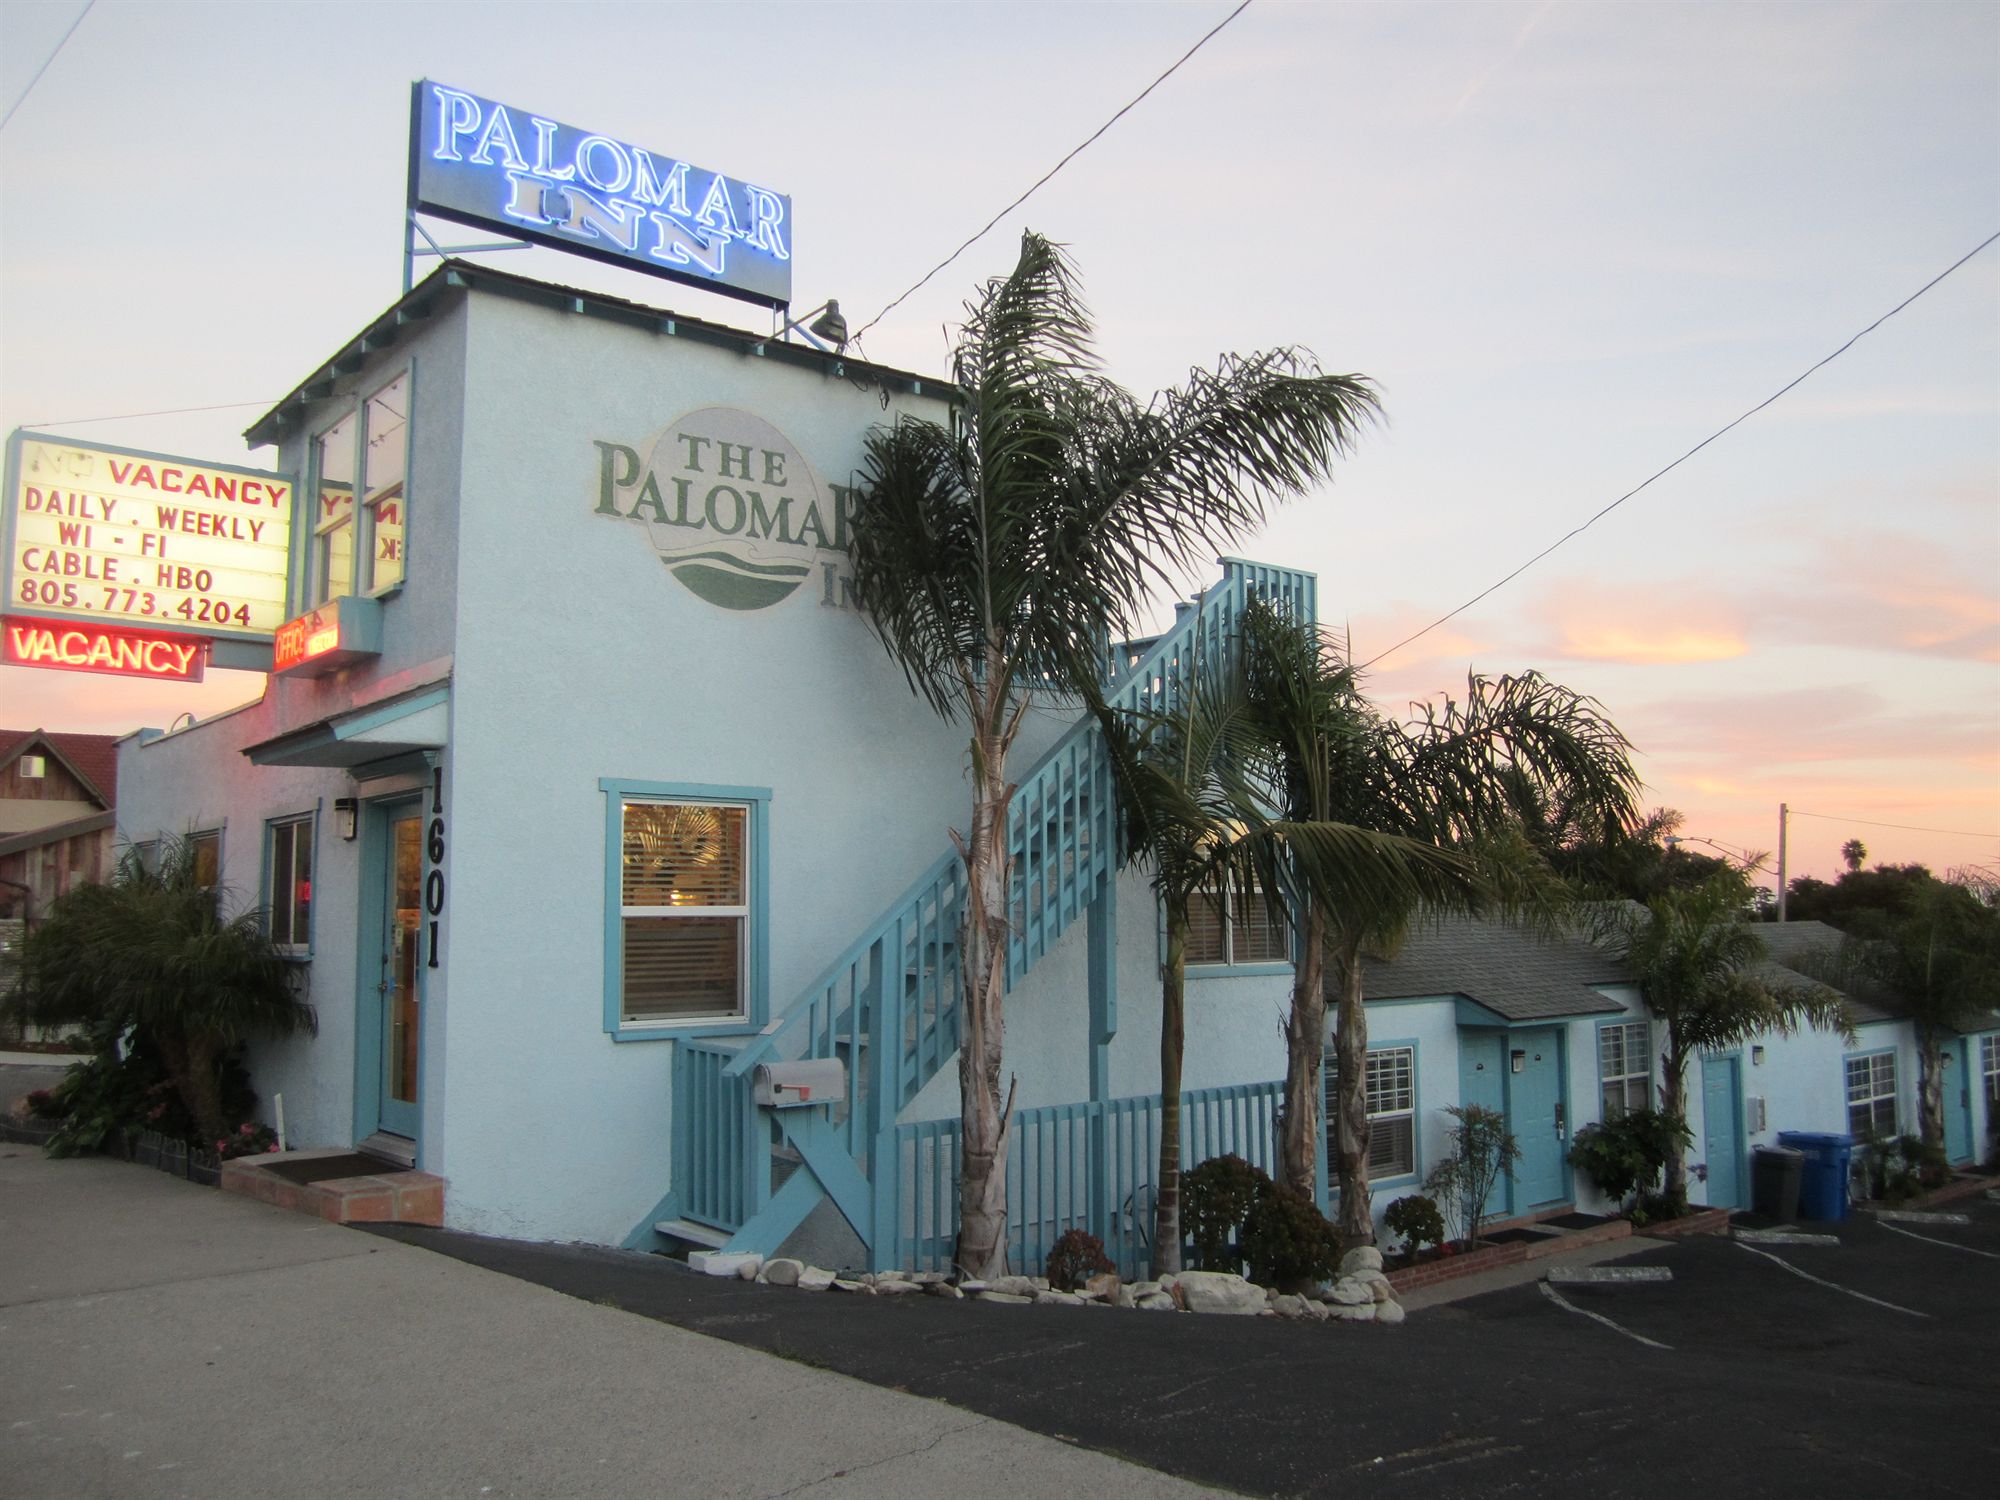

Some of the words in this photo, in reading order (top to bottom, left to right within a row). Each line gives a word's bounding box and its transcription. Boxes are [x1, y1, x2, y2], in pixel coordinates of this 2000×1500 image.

[434, 87, 789, 259] PALOMAR
[505, 170, 731, 273] INN
[109, 459, 287, 508] VACANCY
[678, 432, 788, 487] THE
[25, 487, 117, 521] DAILY
[157, 505, 265, 542] WEEKLY
[22, 547, 118, 581] CABLE
[157, 564, 213, 592] HBO
[20, 578, 250, 626] 805.773.4204
[11, 627, 197, 674] VACANCY
[426, 766, 445, 968] 1601
